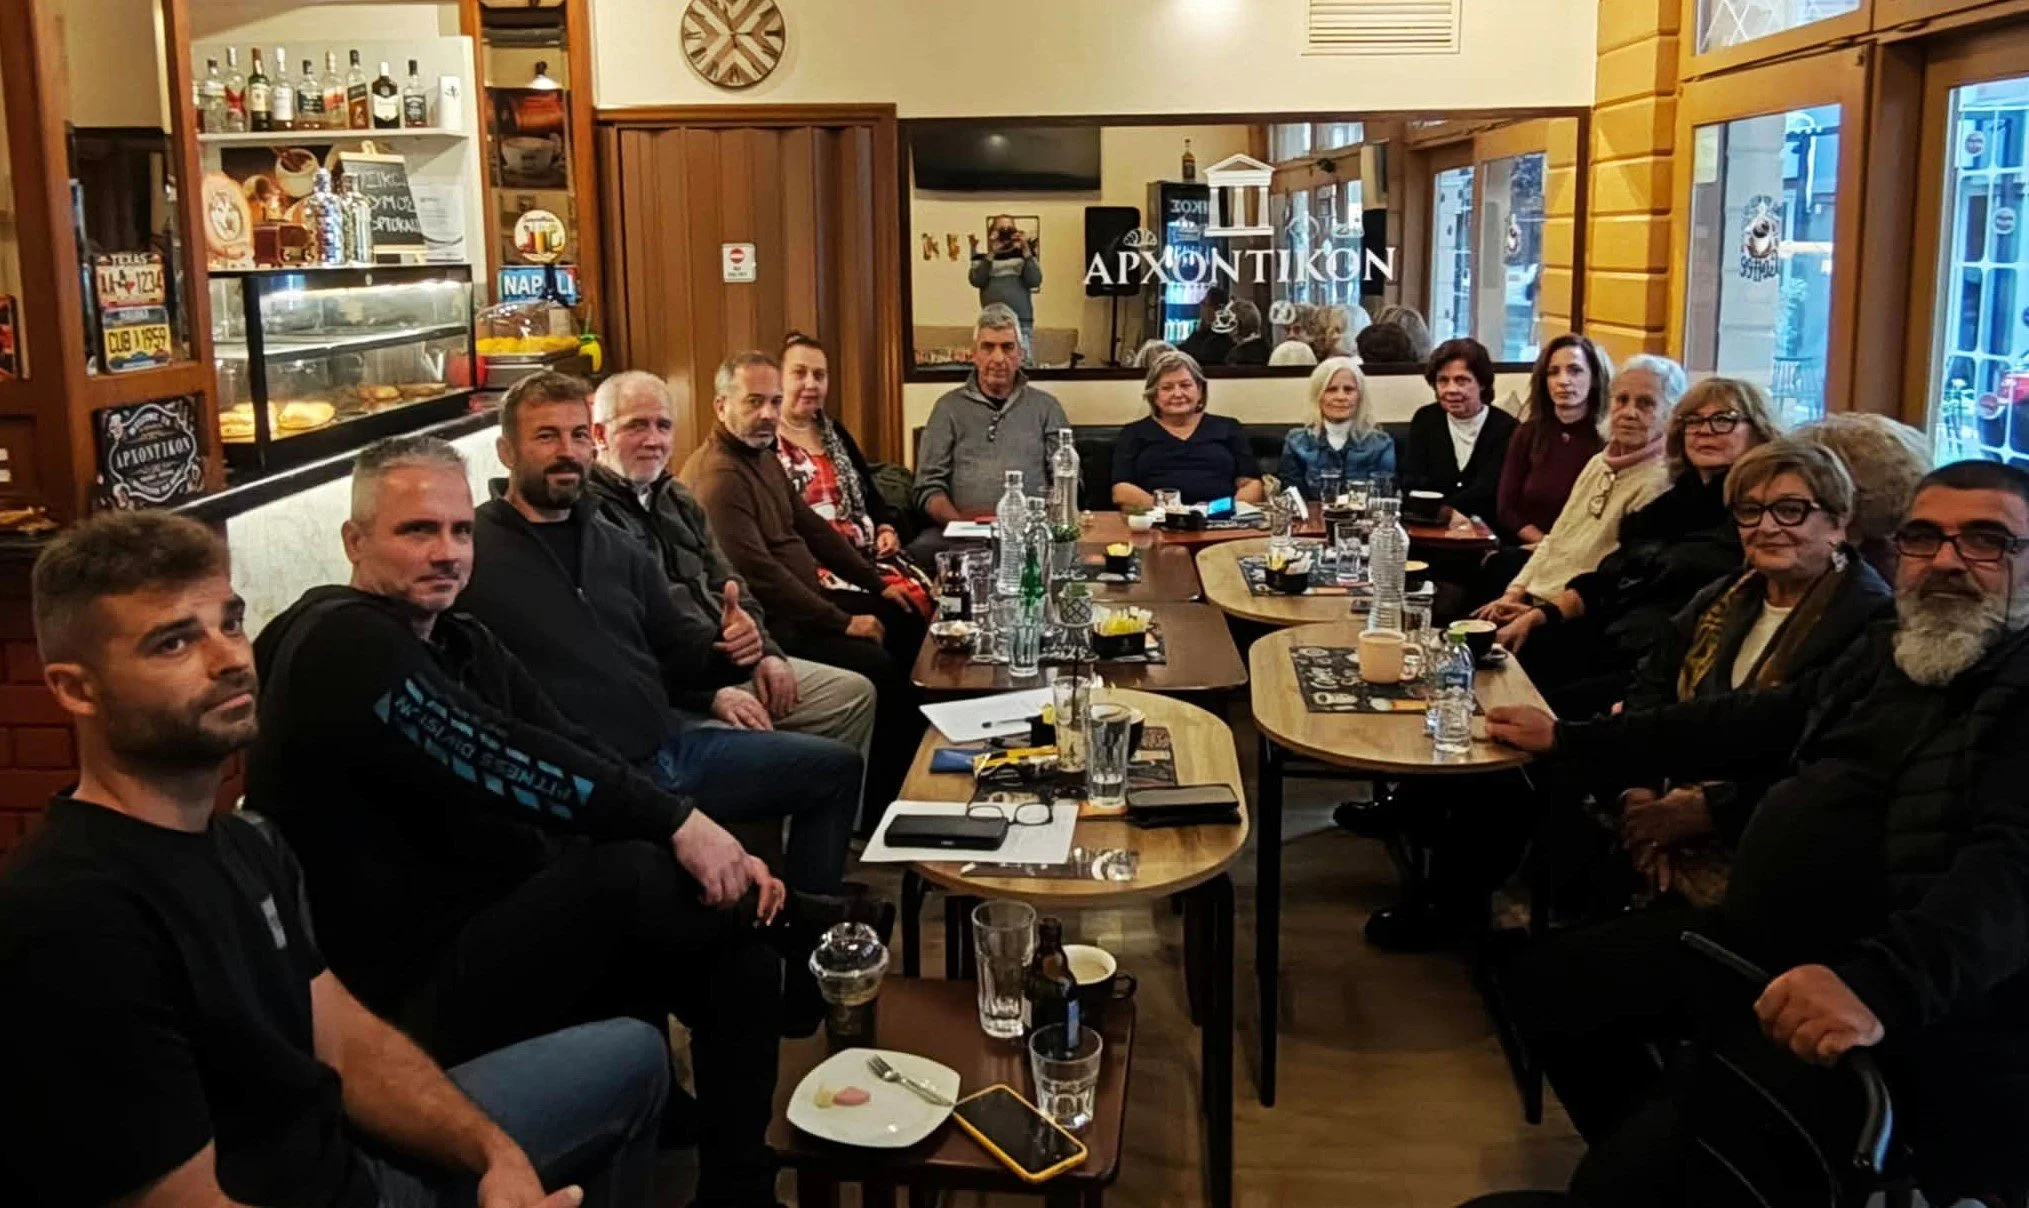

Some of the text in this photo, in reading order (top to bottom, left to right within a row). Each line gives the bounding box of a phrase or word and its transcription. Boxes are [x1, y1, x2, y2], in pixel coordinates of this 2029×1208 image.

[371, 195, 416, 214] ΥΜΟΣ
[1084, 246, 1396, 285] ΑΡΧΟΝΤΙΚΟΝ
[136, 270, 163, 293] 1234
[504, 274, 574, 295] NAPLI
